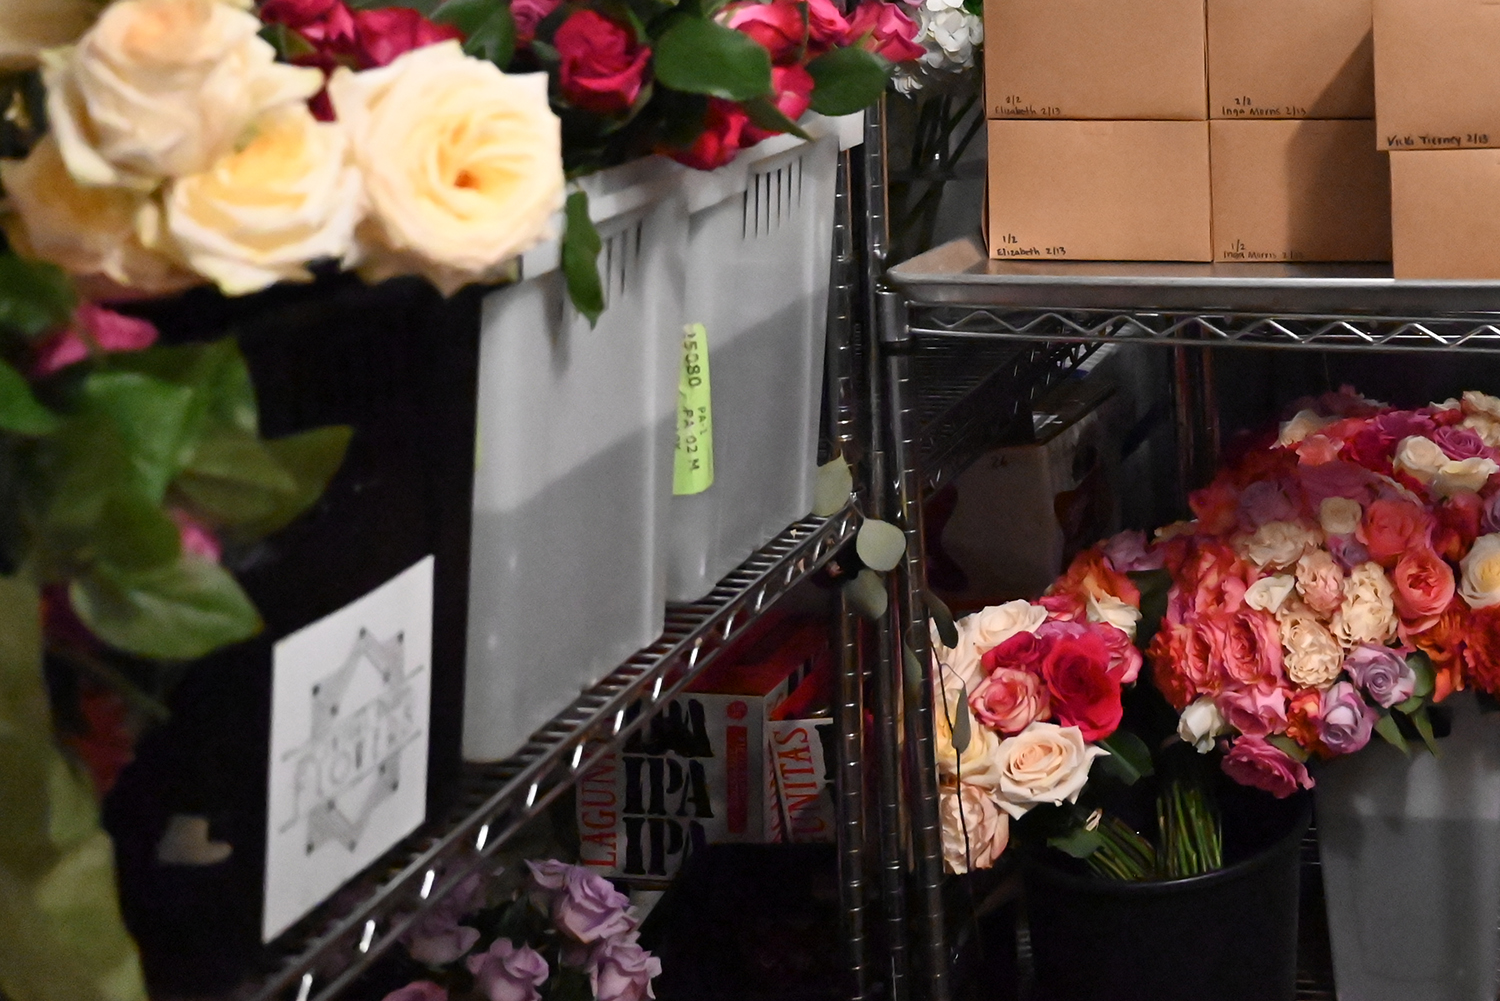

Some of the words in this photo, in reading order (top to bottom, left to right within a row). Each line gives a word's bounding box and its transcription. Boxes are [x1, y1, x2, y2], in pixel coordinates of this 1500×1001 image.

[1041, 106, 1061, 116] 2/13
[1002, 233, 1018, 244] 1/2
[996, 246, 1040, 256] Elizabeth
[1045, 246, 1066, 256] 2/13
[1231, 238, 1246, 252] 1/2
[690, 458, 700, 471] M
[622, 757, 715, 819] IPA
